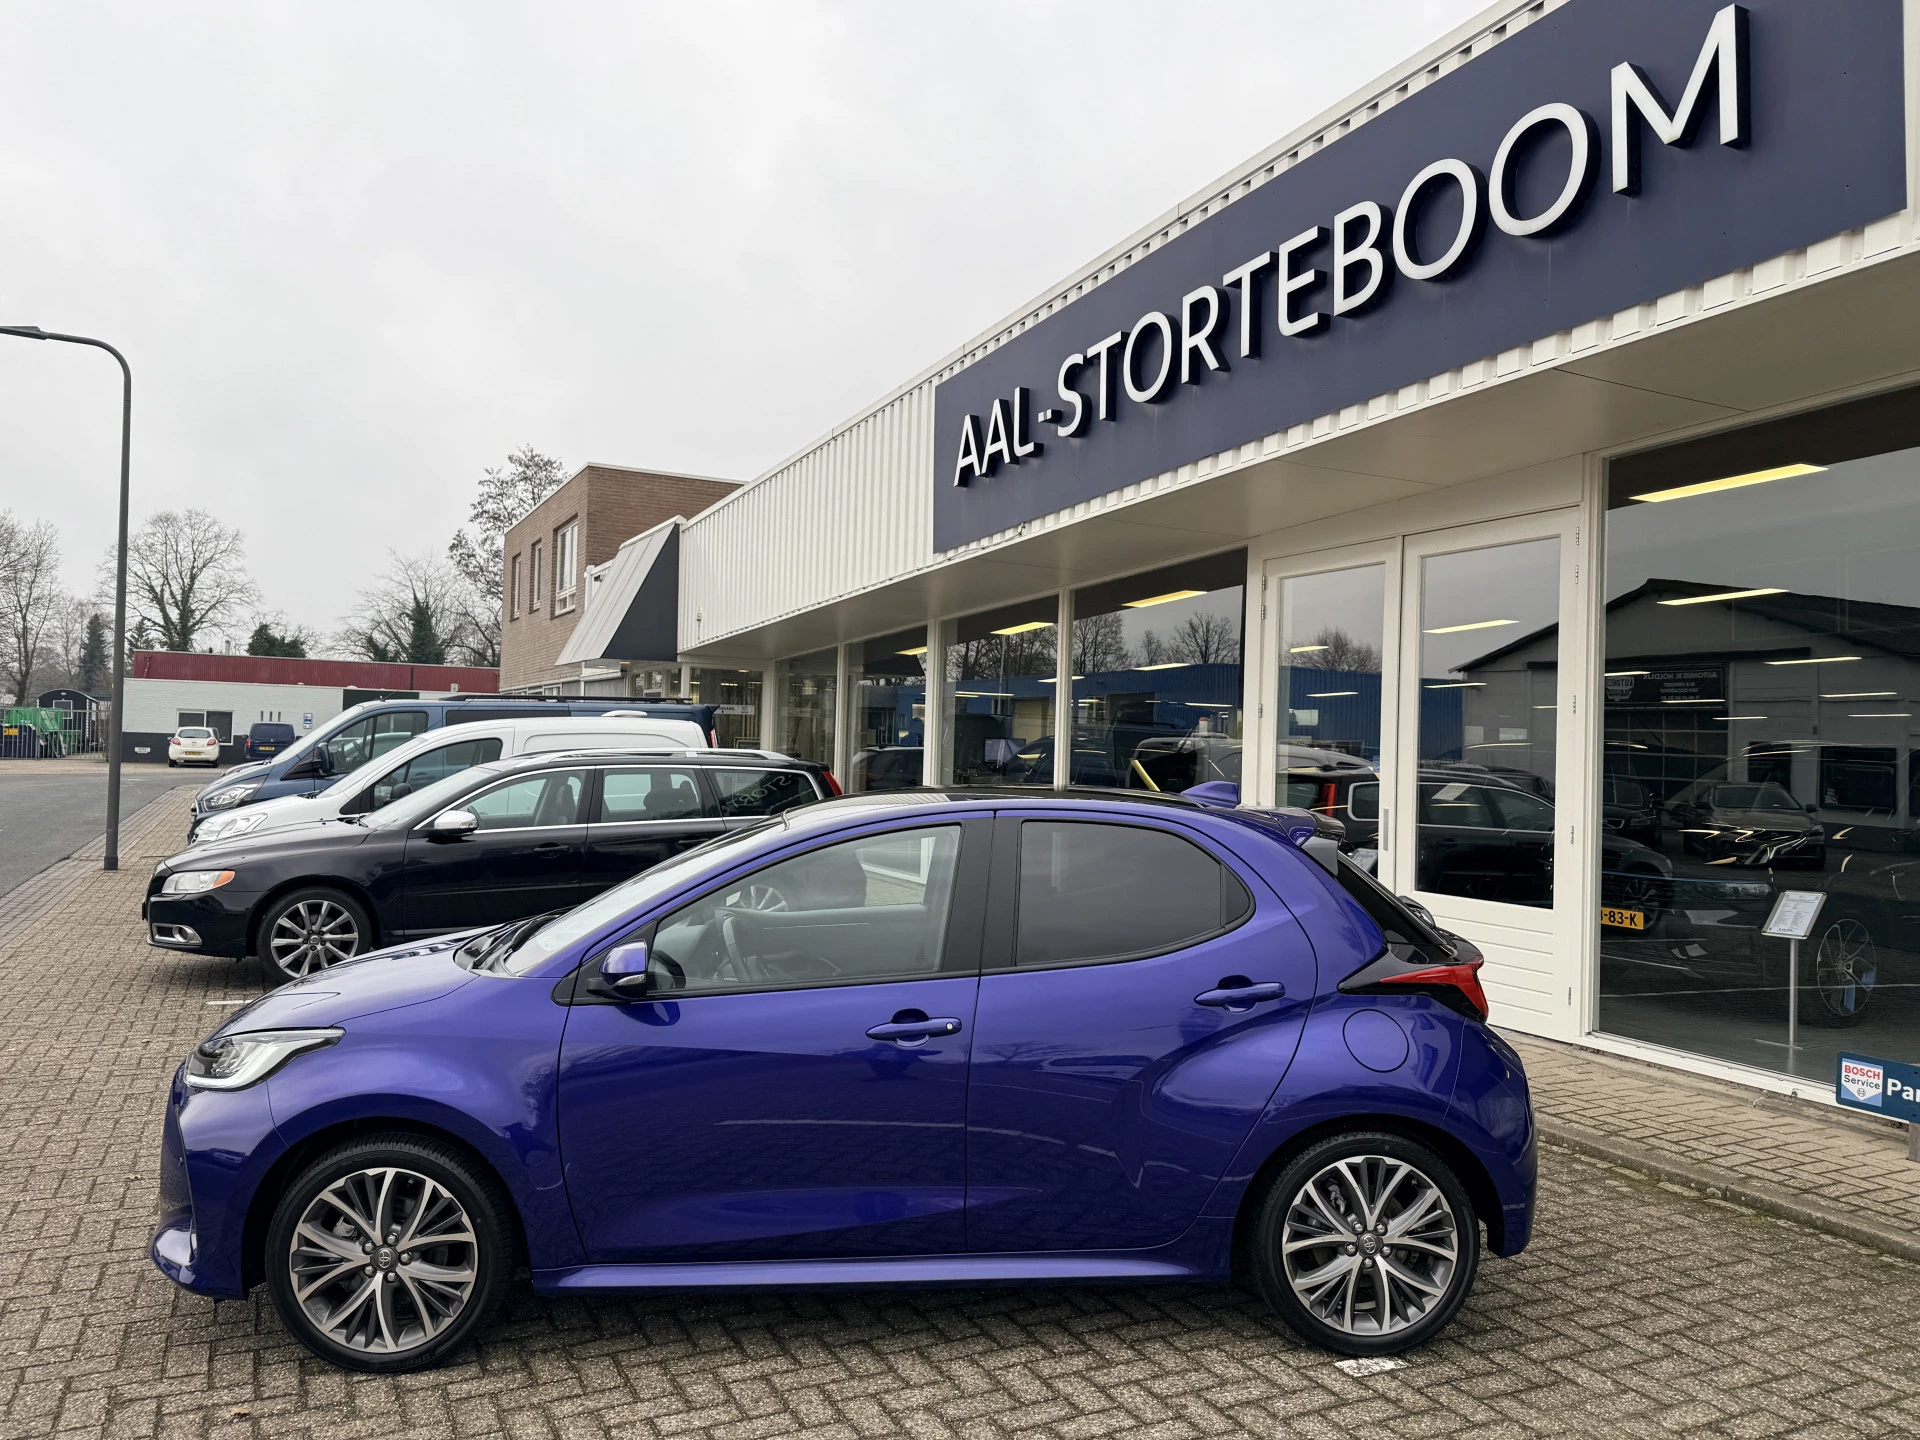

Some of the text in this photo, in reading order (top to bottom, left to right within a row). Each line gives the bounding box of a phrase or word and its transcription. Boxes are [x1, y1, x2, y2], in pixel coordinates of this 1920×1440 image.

[953, 3, 1744, 487] AAL-STORTEBOOM
[1601, 908, 1638, 927] -83-K
[1844, 1064, 1881, 1080] BOSCH
[1843, 1074, 1881, 1090] Service
